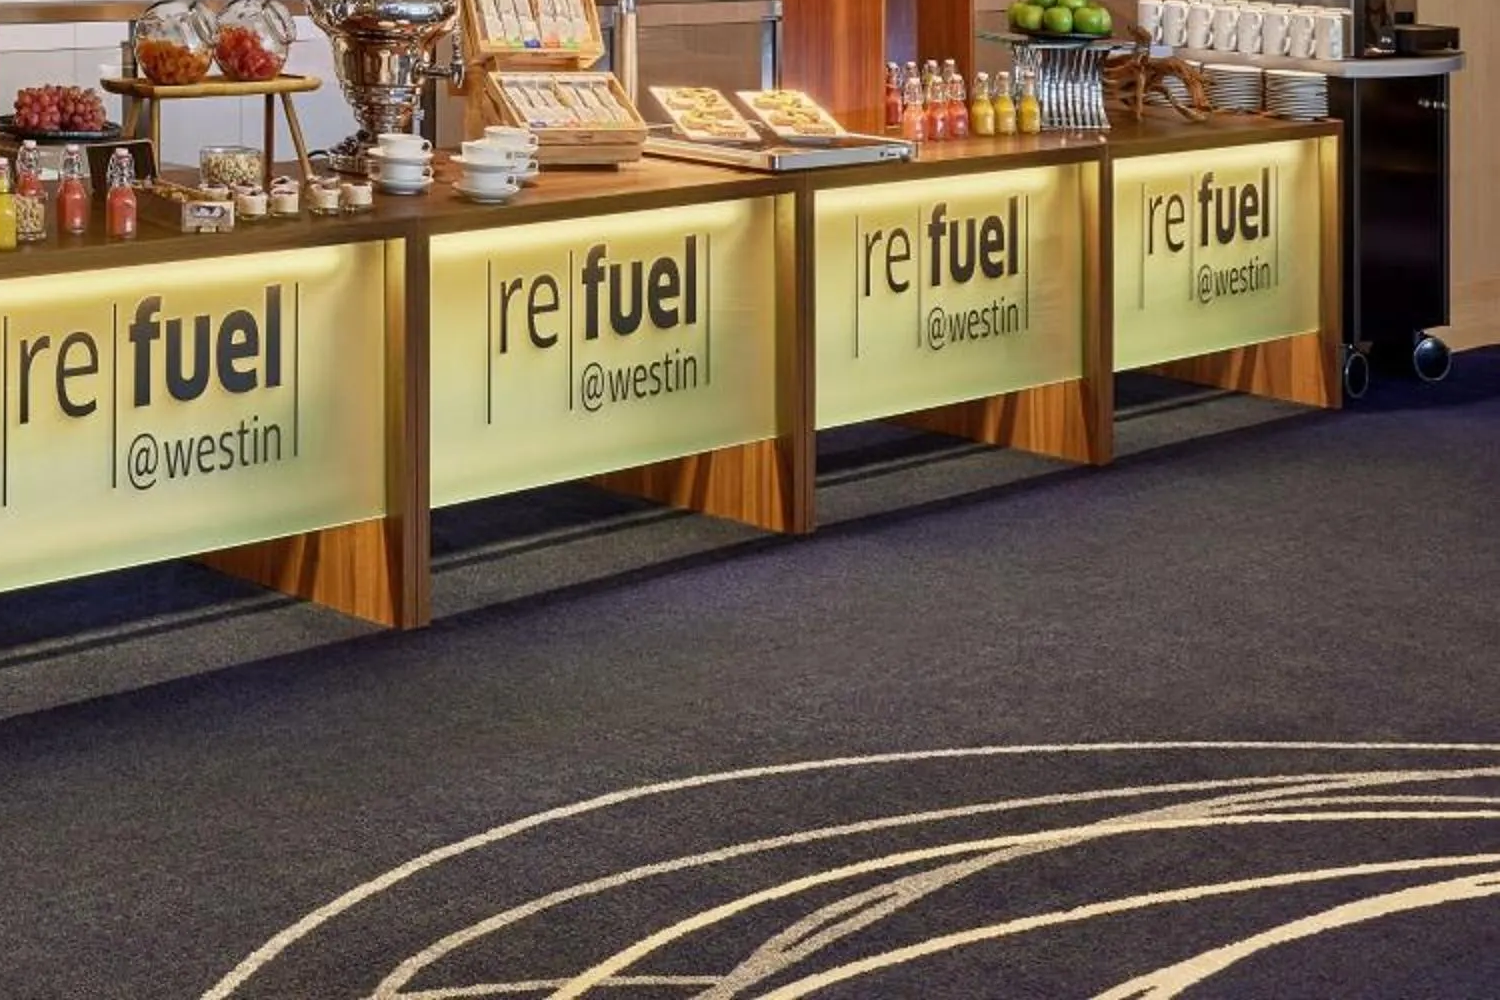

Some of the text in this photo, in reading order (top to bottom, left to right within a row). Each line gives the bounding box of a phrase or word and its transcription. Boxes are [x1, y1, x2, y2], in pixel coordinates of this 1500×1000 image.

[864, 195, 1019, 297] re fuel
[1148, 167, 1269, 255] re fuel
[499, 234, 697, 354] re fuel
[1198, 255, 1271, 304] @westin
[19, 284, 282, 424] re fuel
[927, 296, 1019, 350] @westin
[581, 348, 697, 412] @westin
[128, 415, 282, 490] @westin
